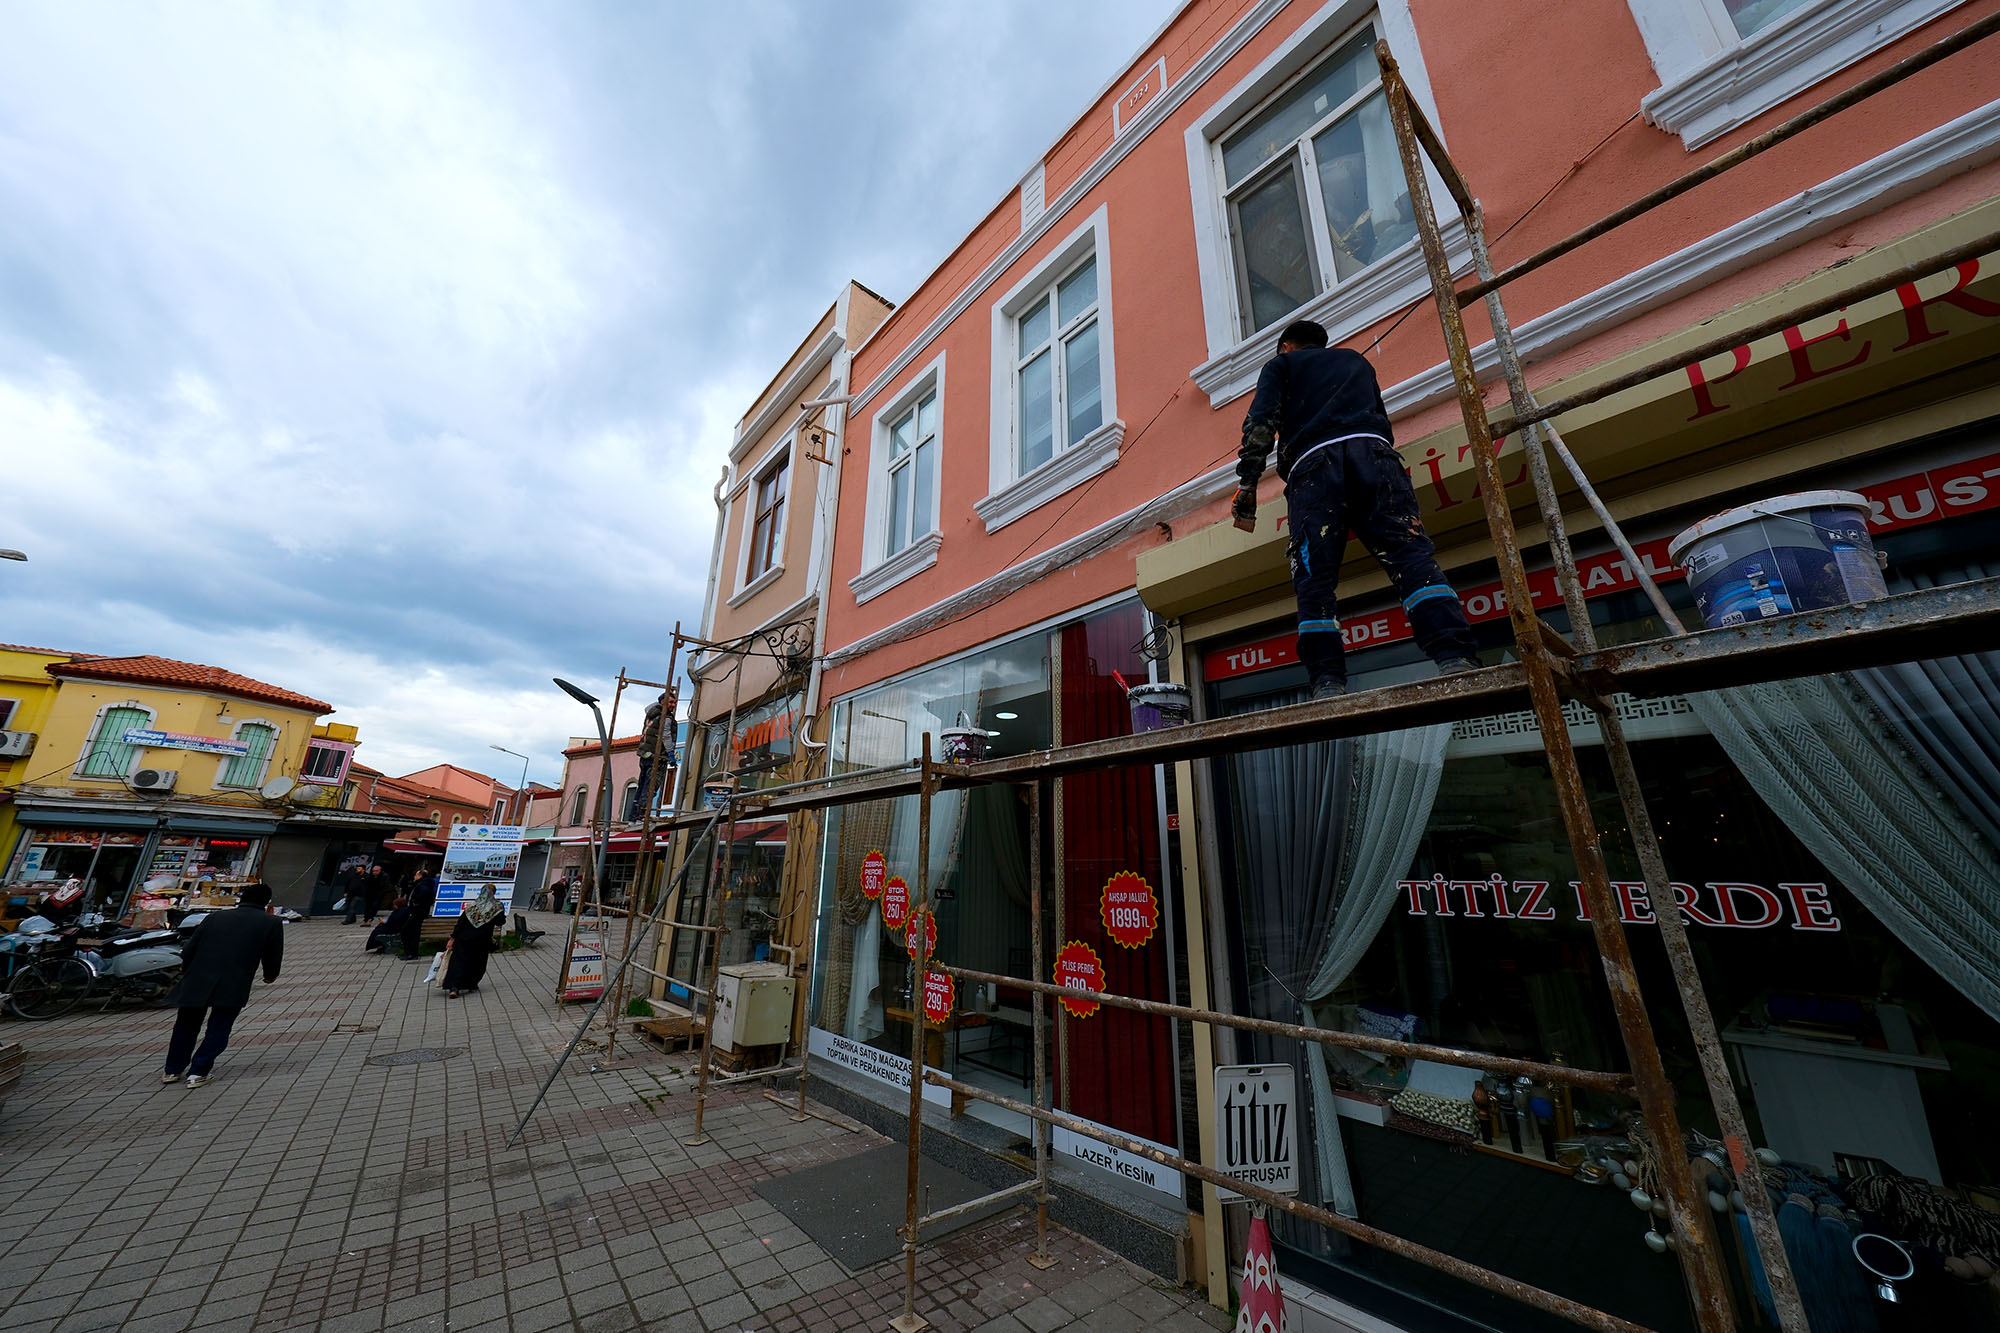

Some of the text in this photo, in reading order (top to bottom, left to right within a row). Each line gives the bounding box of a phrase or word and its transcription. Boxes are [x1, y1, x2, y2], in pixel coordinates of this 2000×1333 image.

[1226, 648, 1271, 670] TÜL
[1340, 618, 1391, 646] RDE
[1554, 554, 1682, 595] KATL
[865, 875, 877, 889] 350
[1108, 891, 1148, 904] AHŞAP JALUZİ
[1397, 872, 1556, 921] TİTİZ
[887, 903, 900, 918] 250
[1110, 907, 1150, 928] 1899 TL
[929, 973, 945, 982] FON
[1062, 959, 1095, 975] PLİSE PERDE
[925, 981, 949, 993] PERDE
[926, 991, 949, 1013] 299 TL
[826, 1047, 849, 1064] TOPTAN
[850, 1056, 858, 1067] VE
[860, 1060, 900, 1084] PERAKENDE
[833, 1038, 912, 1073] FABRİKA SATIŞ MAĞAZAS
[1223, 1081, 1290, 1168] titiz
[1107, 1146, 1118, 1156] ve
[1075, 1145, 1155, 1186] LAZER KESİM
